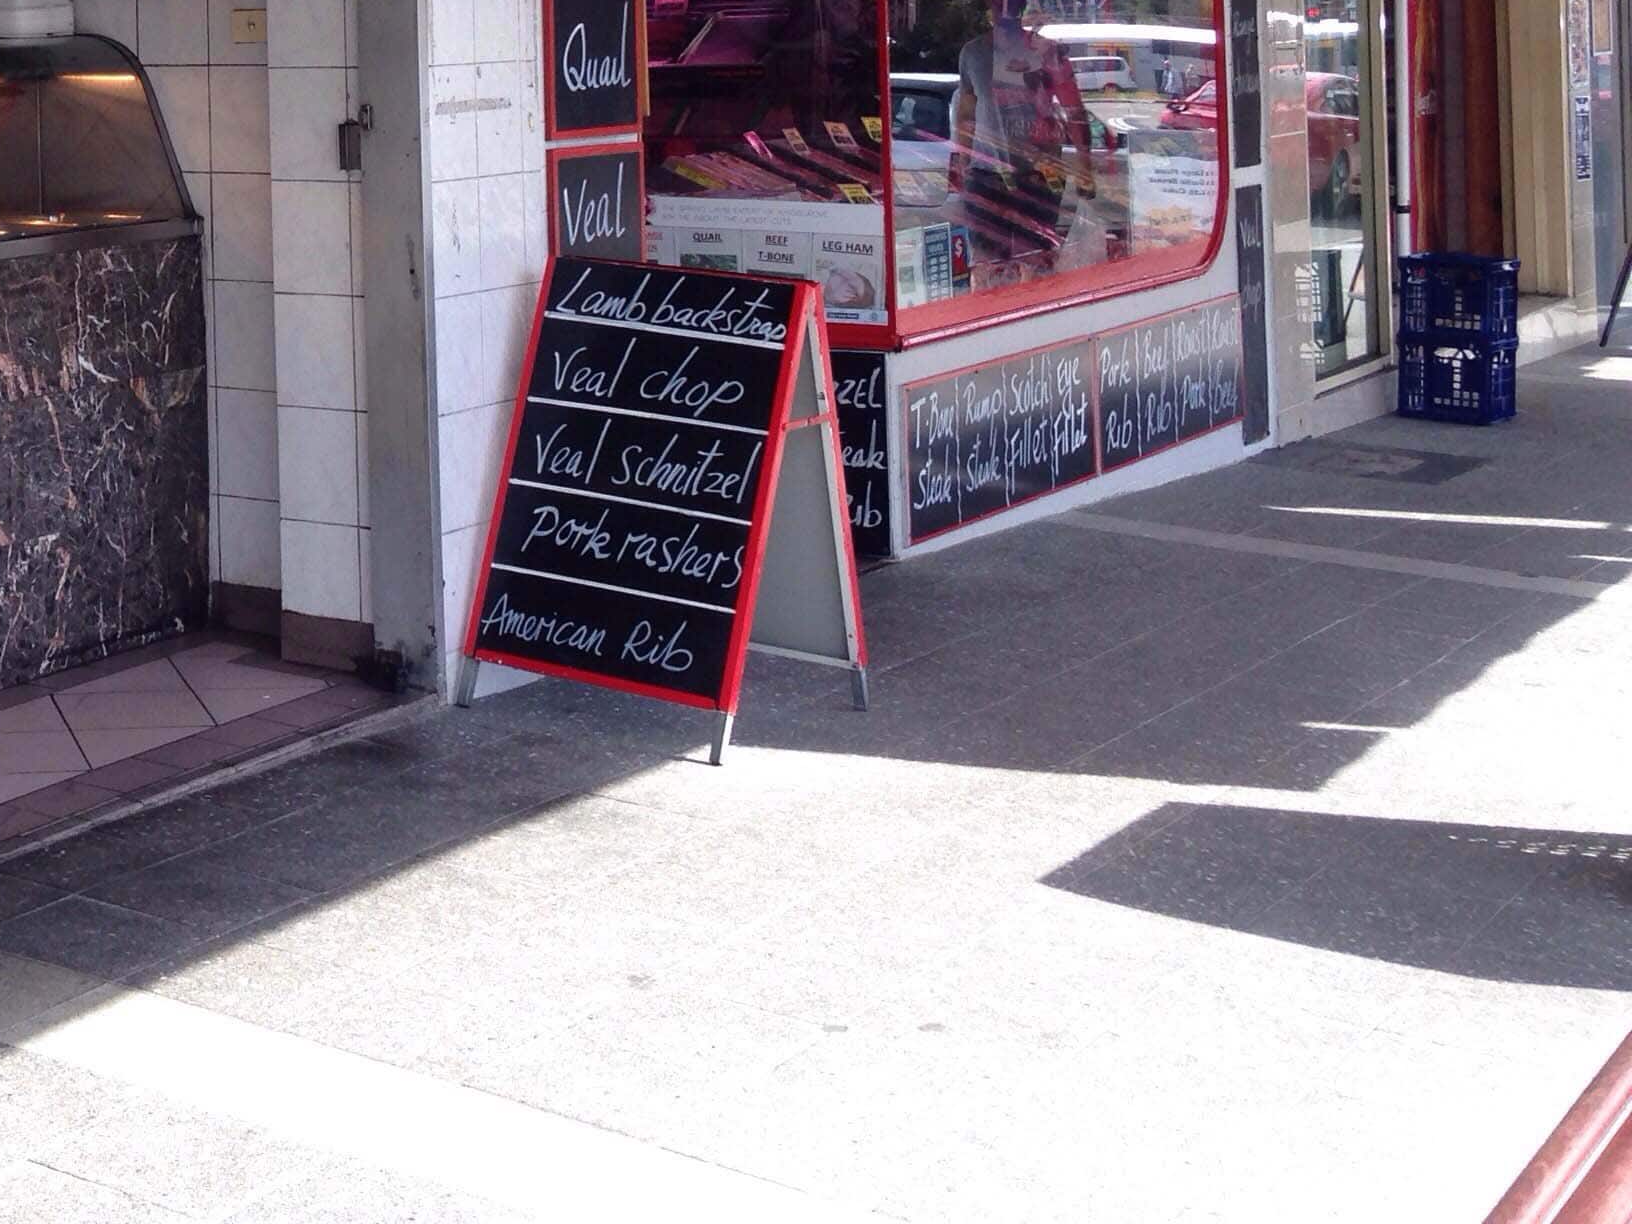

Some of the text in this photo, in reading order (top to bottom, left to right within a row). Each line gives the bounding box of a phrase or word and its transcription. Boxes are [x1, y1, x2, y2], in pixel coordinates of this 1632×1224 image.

[563, 0, 632, 92] Quail
[564, 162, 626, 247] Veal
[692, 232, 723, 243] QUAIL
[758, 251, 795, 264] T-BONE
[765, 235, 789, 246] BEEF
[822, 240, 874, 255] LEG HAM
[556, 267, 787, 342] Lamb backstrap
[554, 337, 637, 398] Veal
[1099, 337, 1132, 394] Pork
[1142, 327, 1169, 397] Beef
[1176, 316, 1208, 362] Roast
[834, 367, 882, 408] ZEL
[963, 381, 1002, 447] Rump
[1009, 353, 1050, 416] Scotch
[1057, 356, 1081, 417] Eye
[535, 418, 613, 484] Veal
[837, 419, 888, 470] eak
[1105, 393, 1133, 454] Rib
[913, 444, 952, 510] Steak
[966, 428, 1002, 493] Steak
[1008, 416, 1048, 495] Fillet
[616, 523, 745, 588] rashers
[481, 592, 693, 672] American Rib
